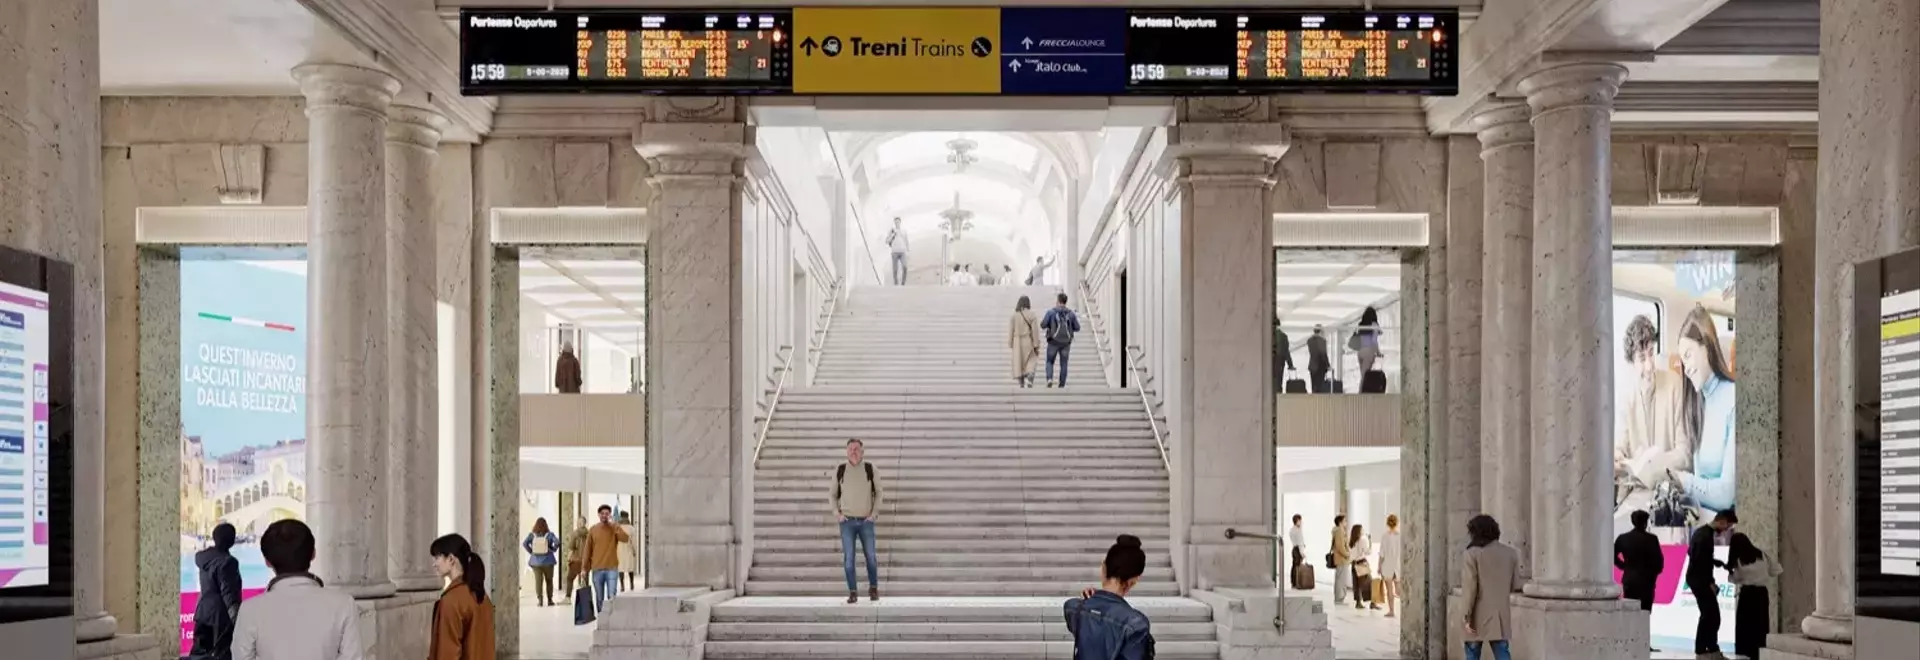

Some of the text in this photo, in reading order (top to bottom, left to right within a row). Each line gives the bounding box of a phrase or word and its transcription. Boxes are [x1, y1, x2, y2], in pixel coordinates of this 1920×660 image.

[514, 16, 557, 30] Departures
[1174, 16, 1217, 30] Departures
[850, 37, 965, 57] Treni Trains
[199, 343, 297, 372] QUEST'INVERNO
[184, 364, 240, 387] LASCIATI
[197, 387, 297, 413] DALLA BELLEZZA
